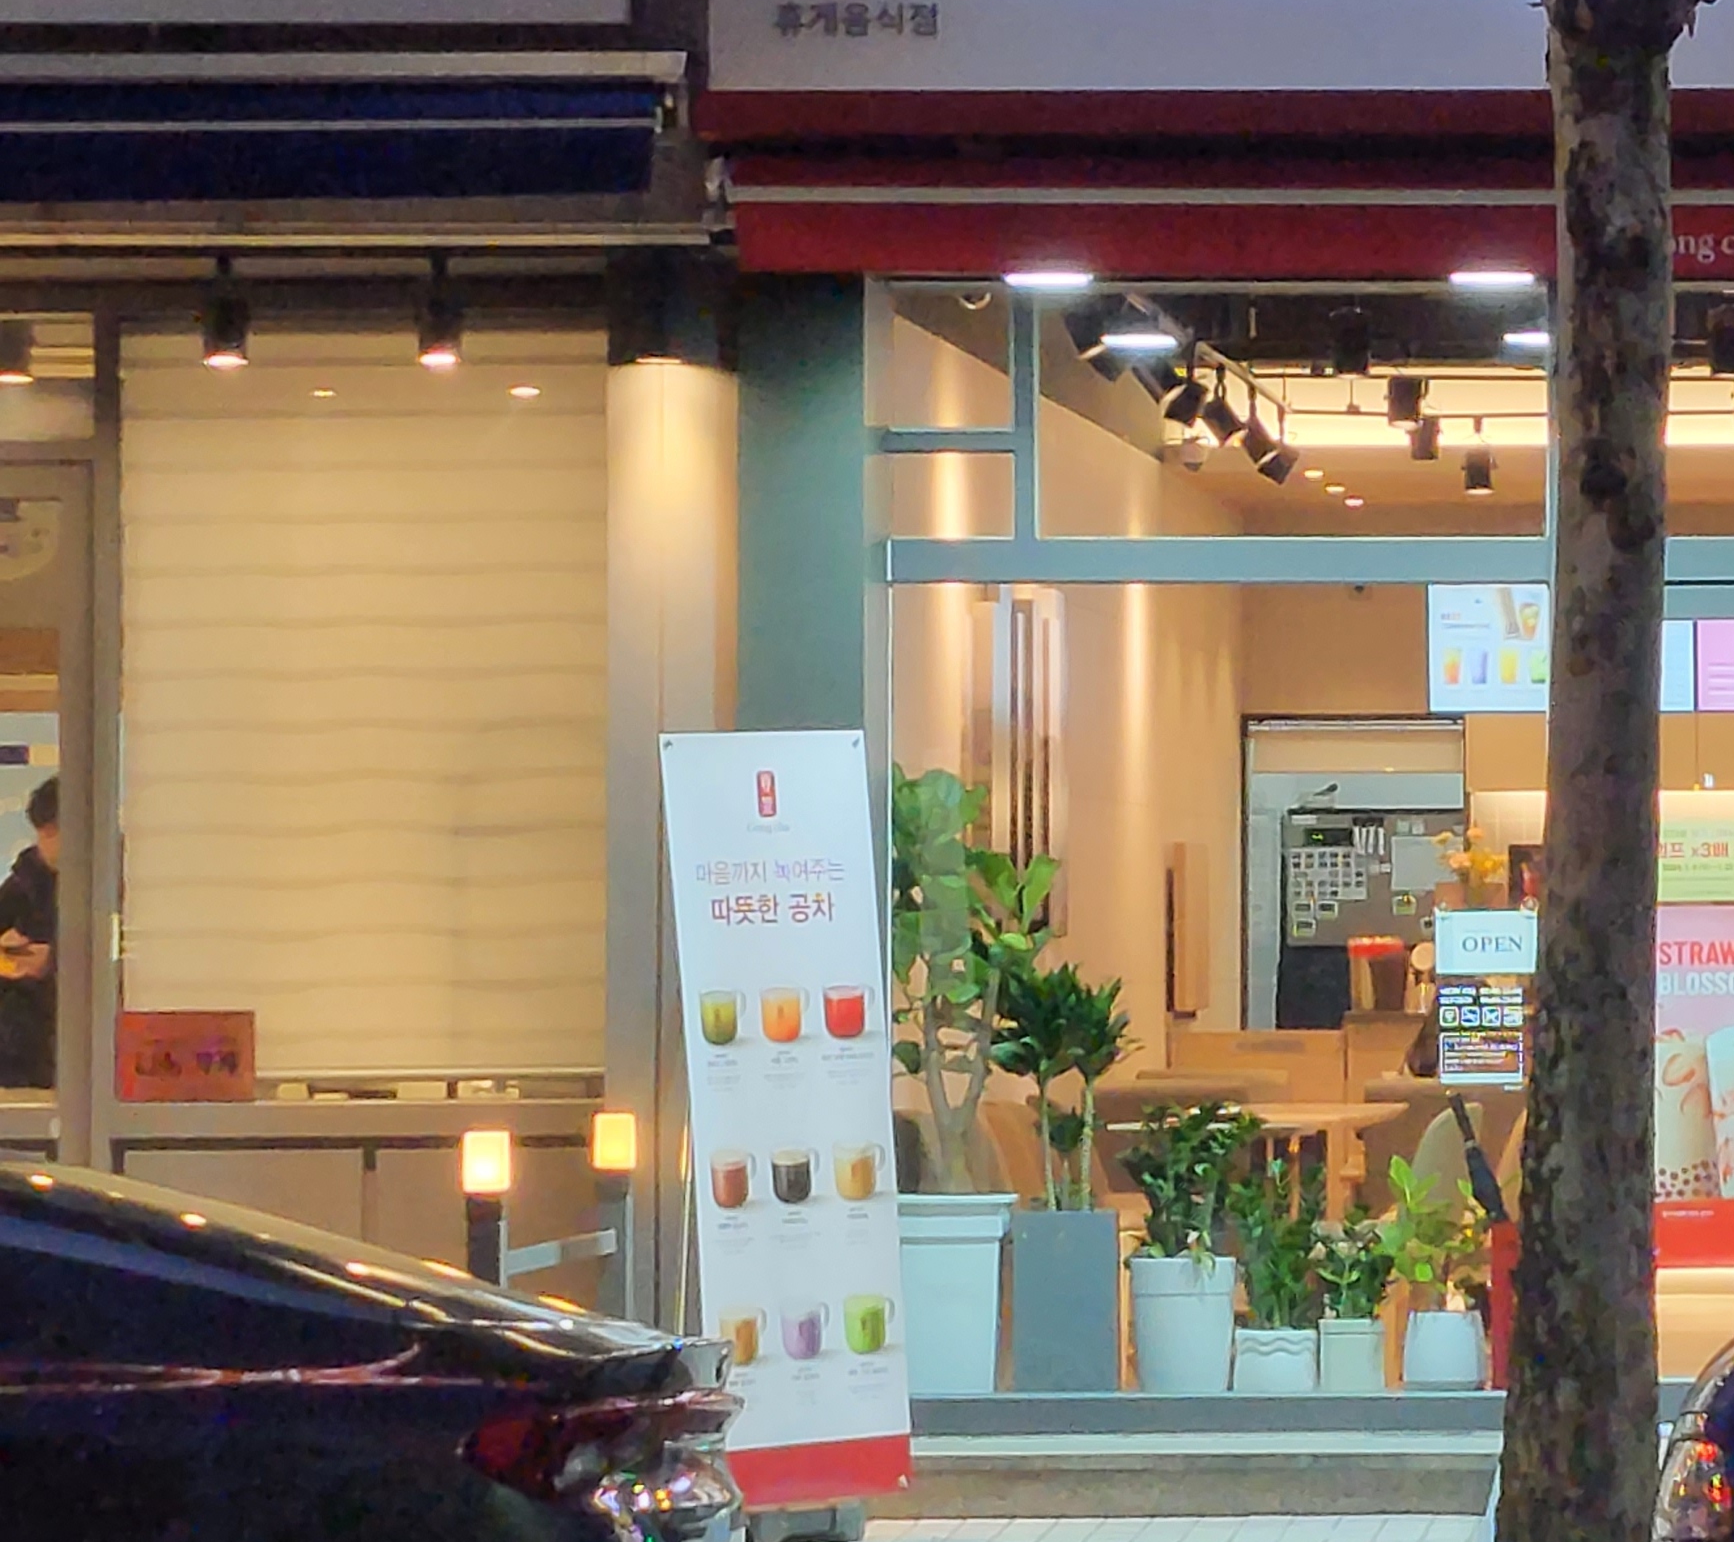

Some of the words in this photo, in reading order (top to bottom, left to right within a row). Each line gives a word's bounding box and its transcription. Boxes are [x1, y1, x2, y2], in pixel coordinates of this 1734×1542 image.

[695, 860, 768, 886] 마음까지
[710, 893, 779, 927] 따뜻한
[787, 891, 836, 924] 공차
[1462, 936, 1522, 952] OPEN
